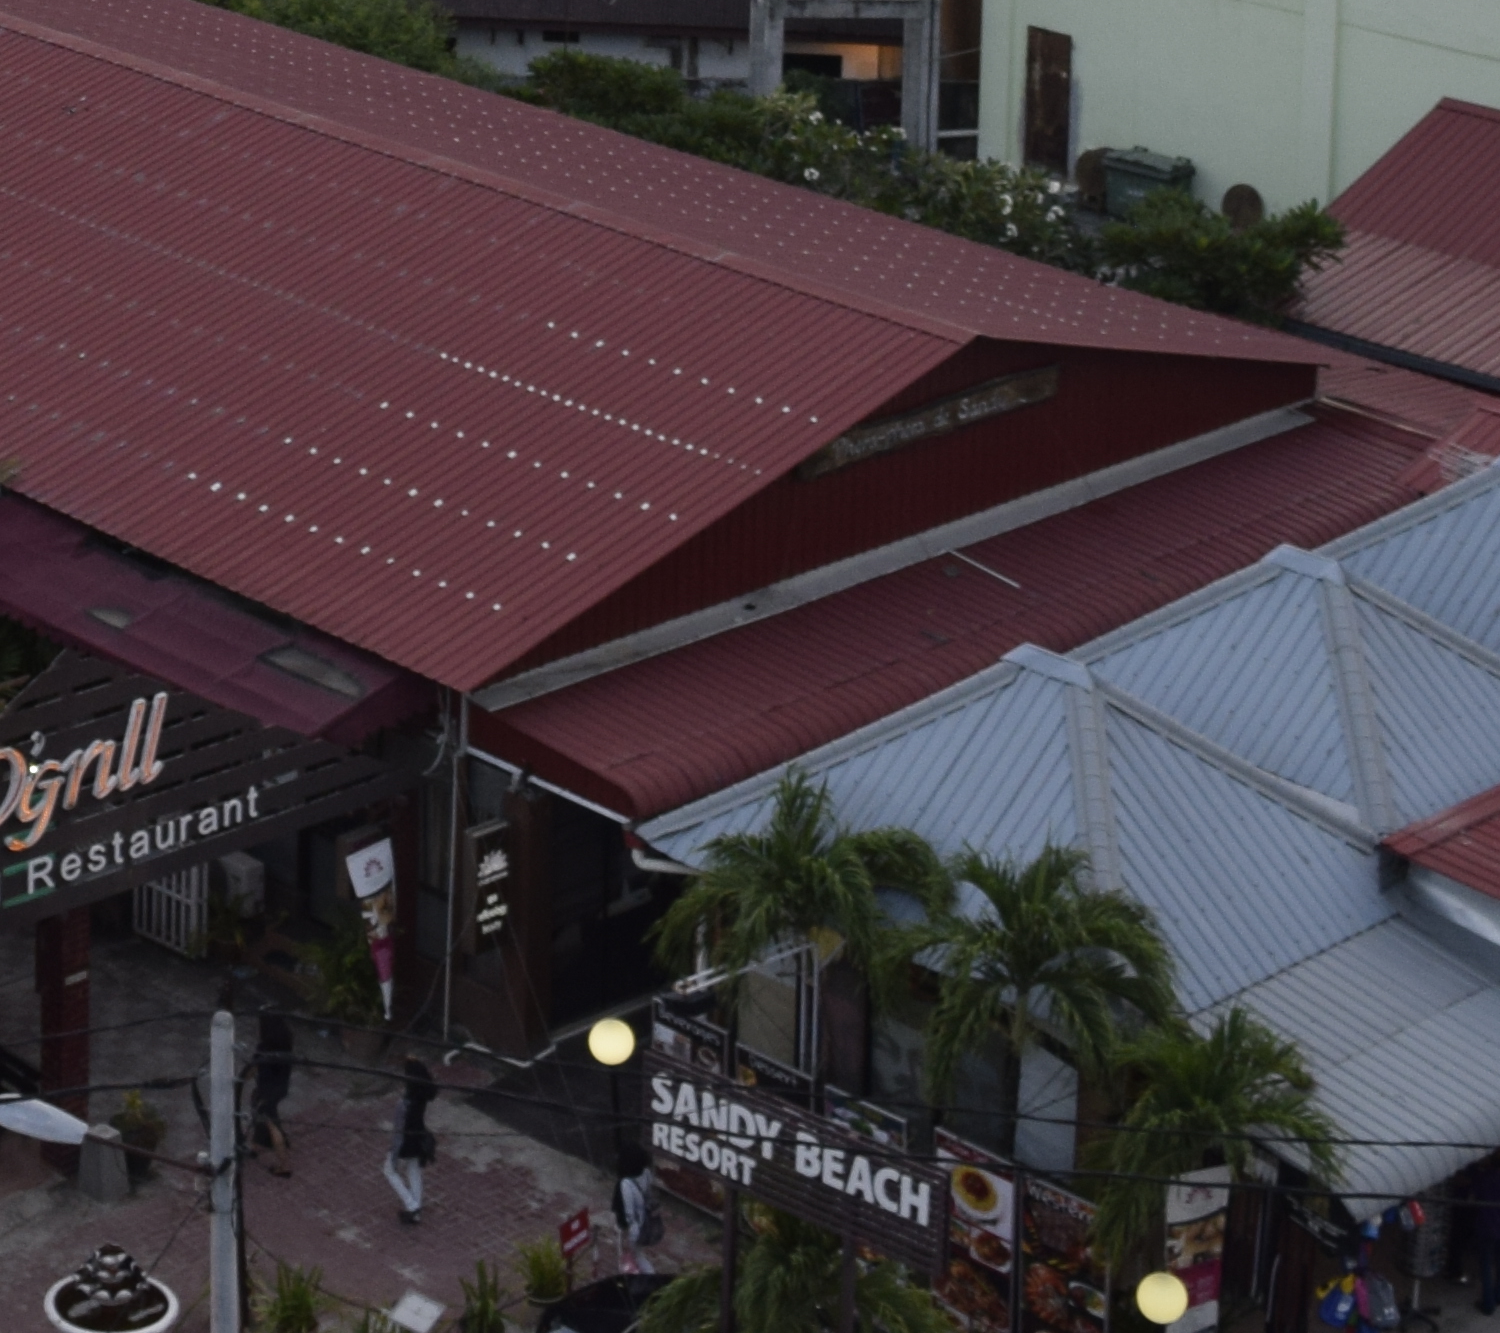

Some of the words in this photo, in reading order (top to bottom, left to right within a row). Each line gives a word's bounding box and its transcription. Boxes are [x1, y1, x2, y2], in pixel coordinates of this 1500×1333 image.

[26, 785, 260, 895] Restaurant
[650, 1072, 782, 1160] SANDY
[794, 1130, 931, 1228] BEACH
[651, 1122, 758, 1186] RESORT
